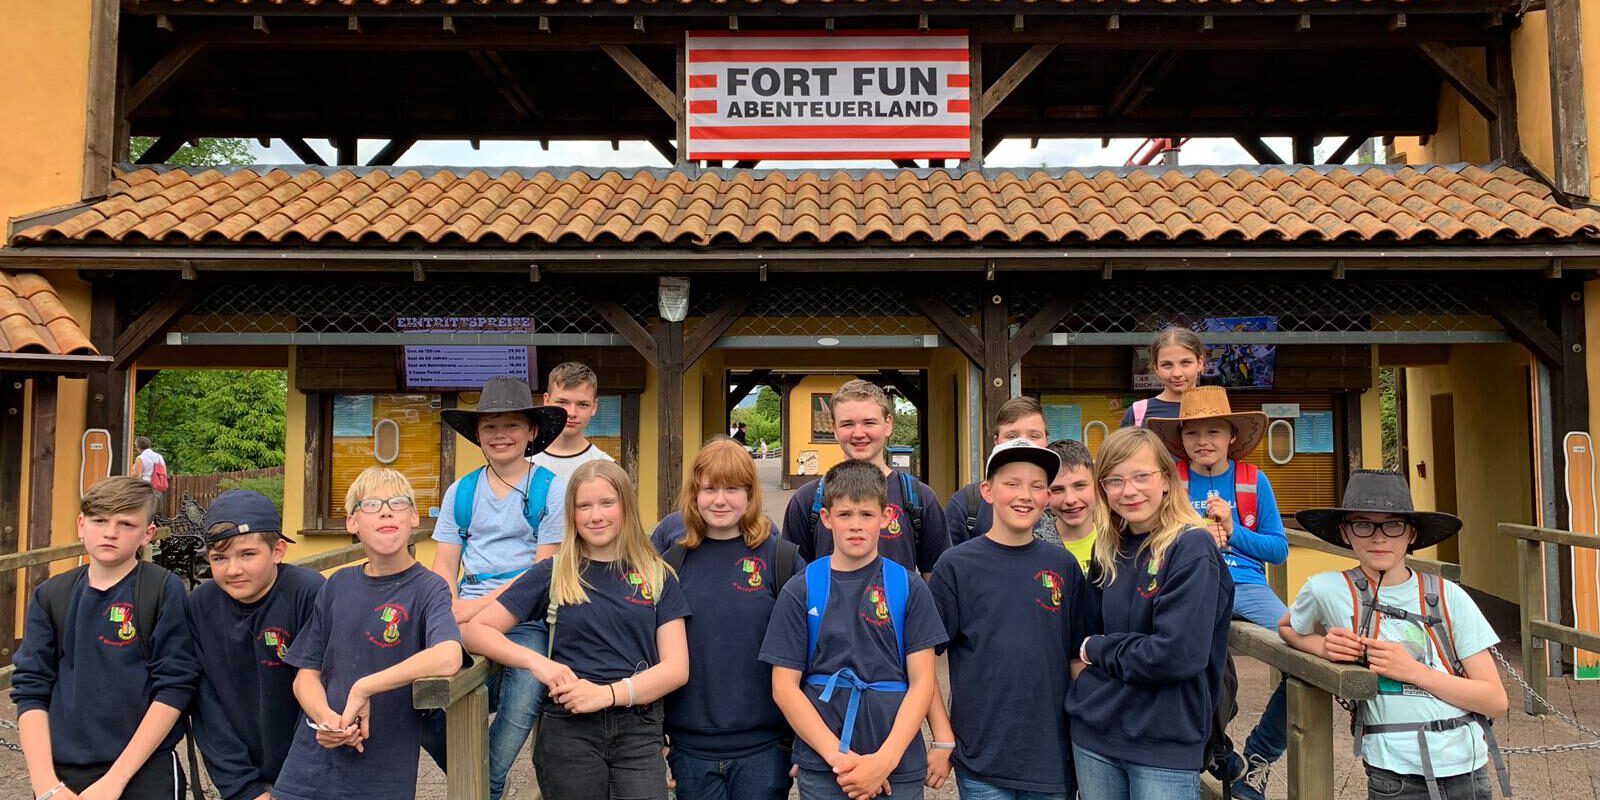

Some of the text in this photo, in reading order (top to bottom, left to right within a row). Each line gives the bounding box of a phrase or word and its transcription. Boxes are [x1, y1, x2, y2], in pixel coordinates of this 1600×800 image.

[727, 67, 937, 96] FORT FUN
[727, 101, 938, 118] ABENTEUERLAND
[396, 317, 530, 328] EINTRITTSPREISE
